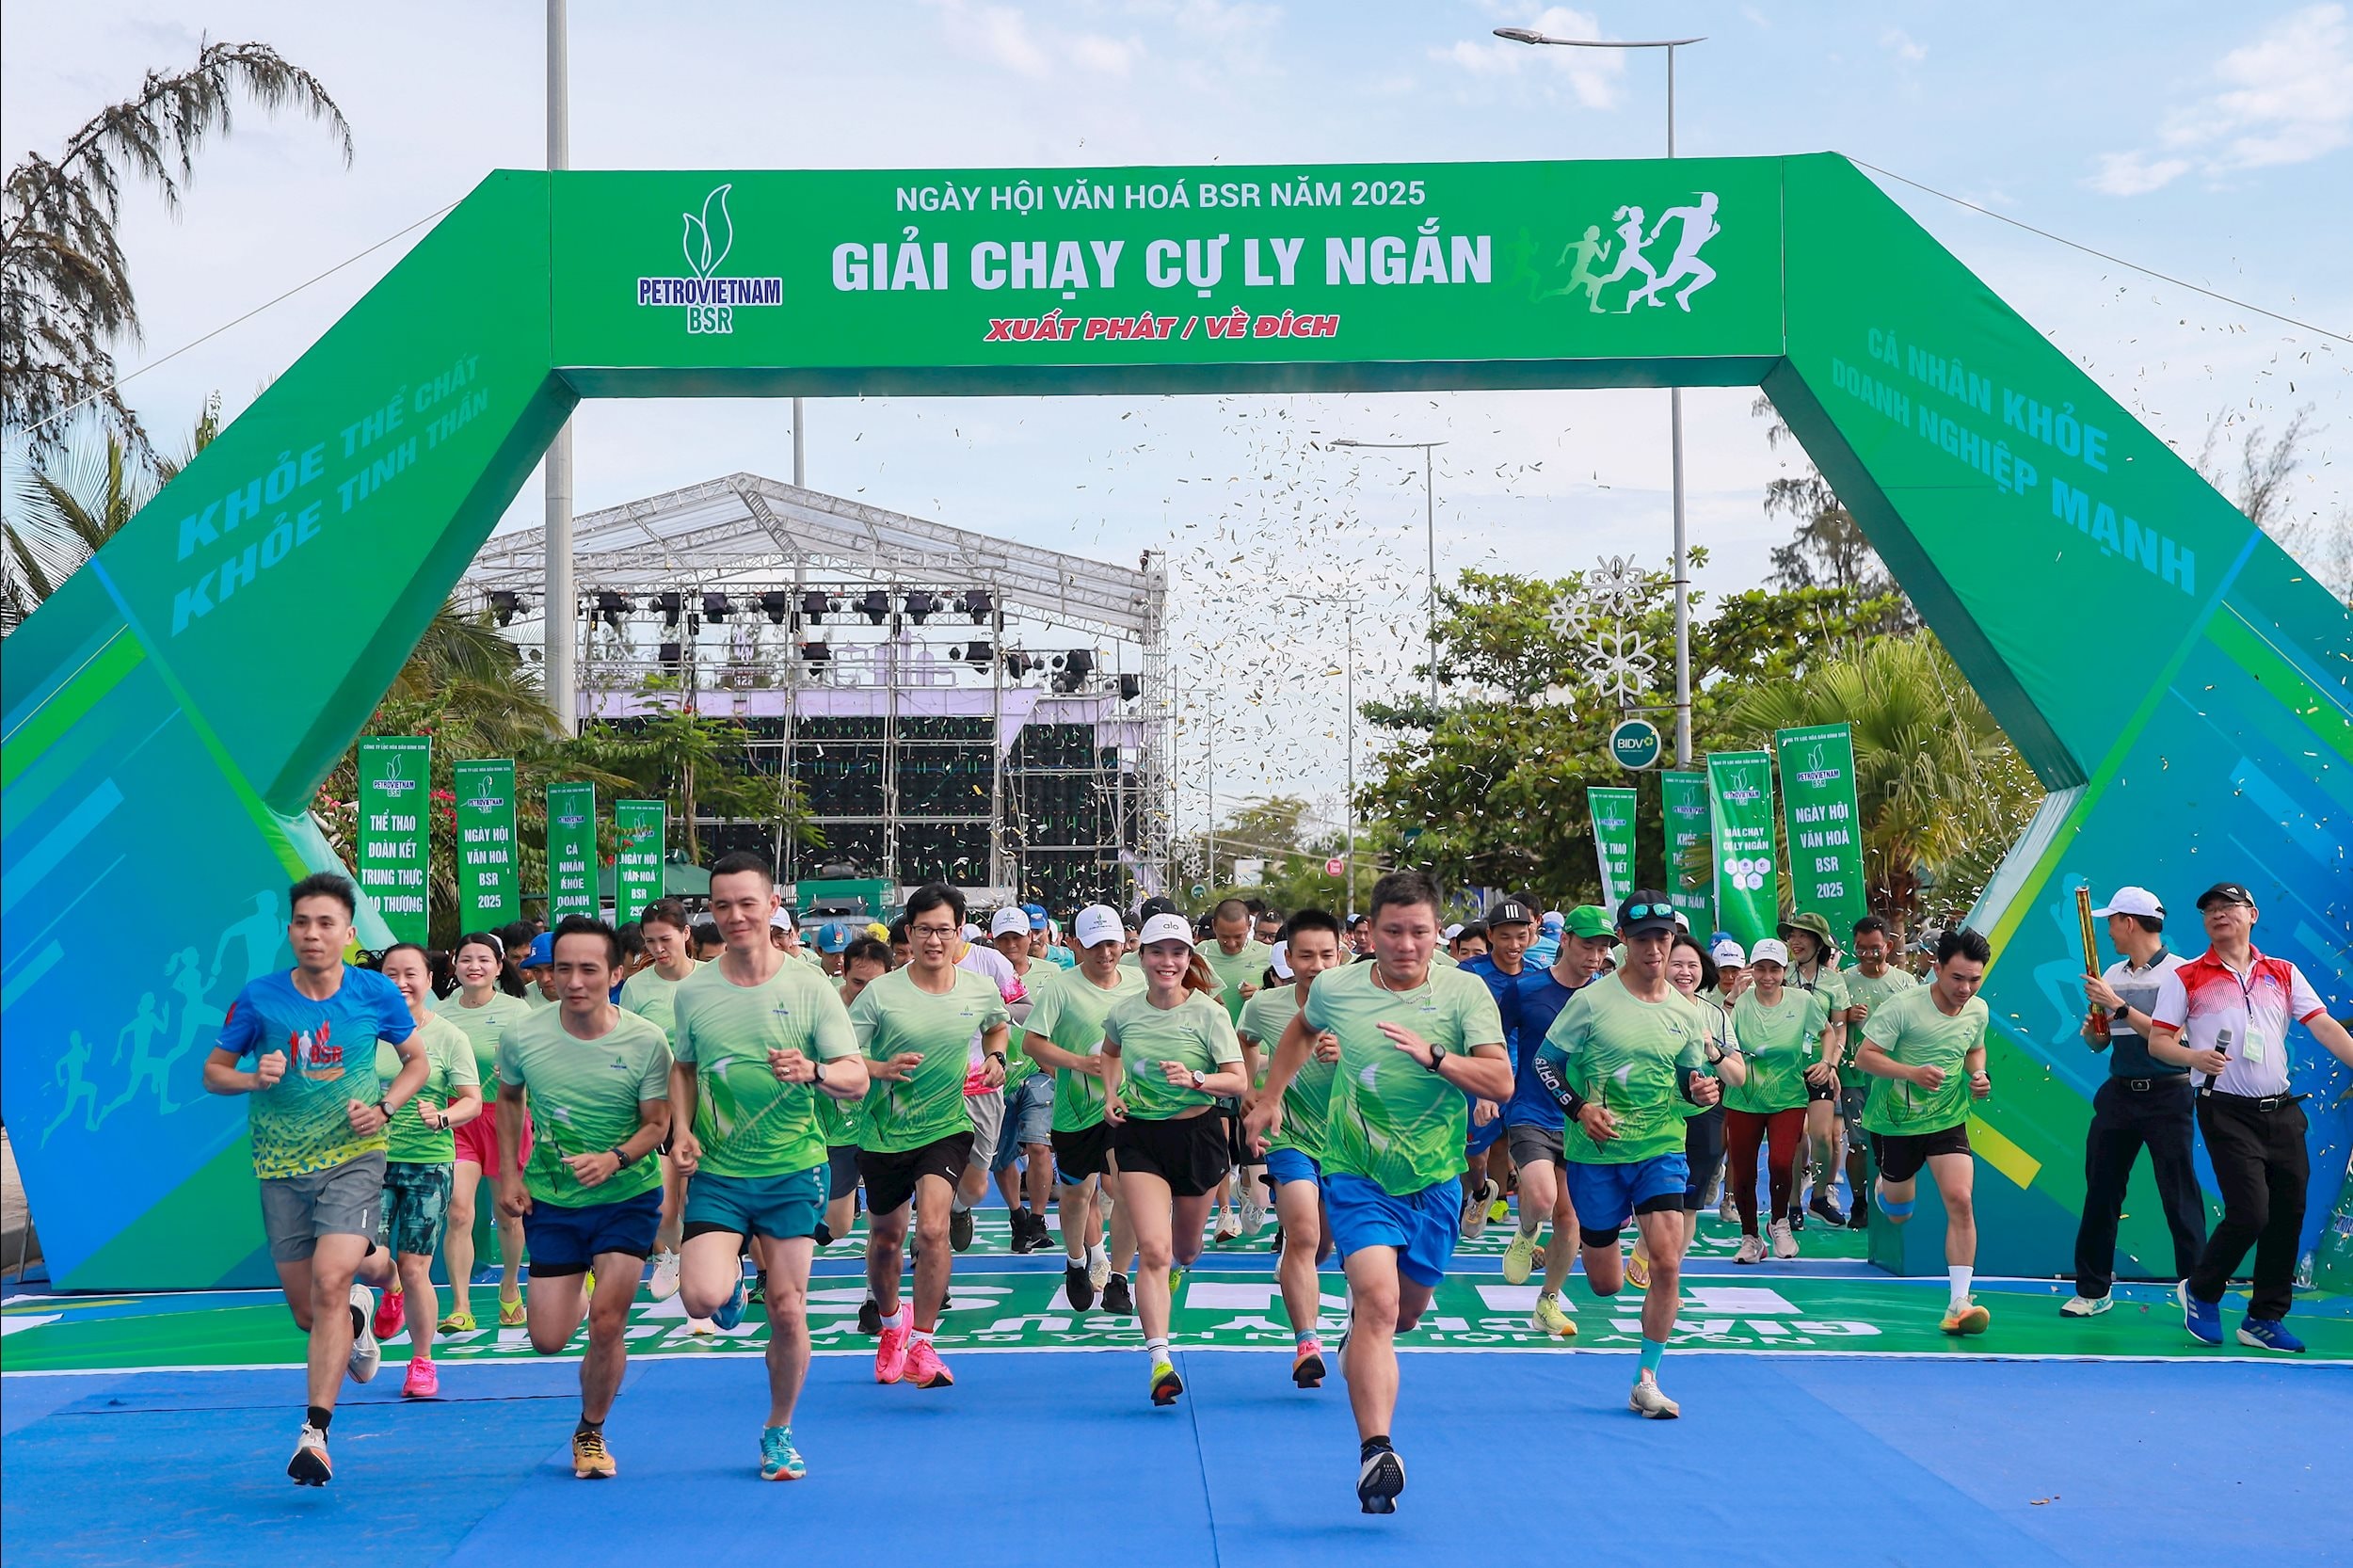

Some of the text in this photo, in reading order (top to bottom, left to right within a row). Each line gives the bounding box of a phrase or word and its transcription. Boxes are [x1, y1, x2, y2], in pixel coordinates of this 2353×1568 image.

[896, 175, 1426, 216] NGÀY HỘI VĂN HOÁ BSR NĂM 2025
[831, 216, 1492, 299] GIẢI CHẠY CỰ LY NGẮN
[637, 277, 783, 307] PETROVIETNAM
[686, 305, 734, 334] BSR
[984, 307, 1080, 343] XUẤT
[1083, 311, 1176, 341] PHÁT
[1206, 306, 1249, 340] VỀ
[1253, 310, 1340, 340] ĐÍCH
[1867, 328, 2108, 474] CÁ NHÂN KHỎE
[177, 353, 479, 563] KHỎE THỂ CHẤT
[1833, 358, 2195, 597] DOANH NGHIỆP MẠNH
[171, 387, 488, 638] KHỎE TINH THẦN
[1617, 738, 1644, 749] BIDV
[1797, 769, 1840, 782] PETROVIETNAM
[370, 808, 416, 831] THỂ THAO
[1795, 801, 1849, 824] NGÀY HỘI
[464, 825, 509, 843] NGÀY HỘI
[1742, 827, 1765, 839] CHẠY
[1800, 825, 1849, 848] VĂN HOÁ
[368, 838, 417, 858] ĐOÀN KẾT
[566, 841, 578, 855] CÁ
[1609, 843, 1627, 855] THAO
[1734, 841, 1743, 851] LY
[467, 847, 508, 864] VĂN HOÁ
[621, 852, 657, 867] NGÀY HỘI
[1816, 856, 1839, 872] BSR
[559, 859, 584, 872] NHÂN
[1614, 858, 1627, 873] KẾT
[361, 868, 423, 888] TRUNG THỰC
[479, 872, 499, 886] BSR
[640, 870, 656, 882] HOÁ
[631, 888, 647, 899] BSR
[1817, 882, 1844, 899] 2025
[384, 895, 424, 916] THƯỢNG
[478, 894, 501, 908] 2025
[557, 895, 589, 906] DOANH
[1672, 893, 1687, 907] TINH
[1162, 920, 1179, 930] alo
[312, 1045, 344, 1064] BSR
